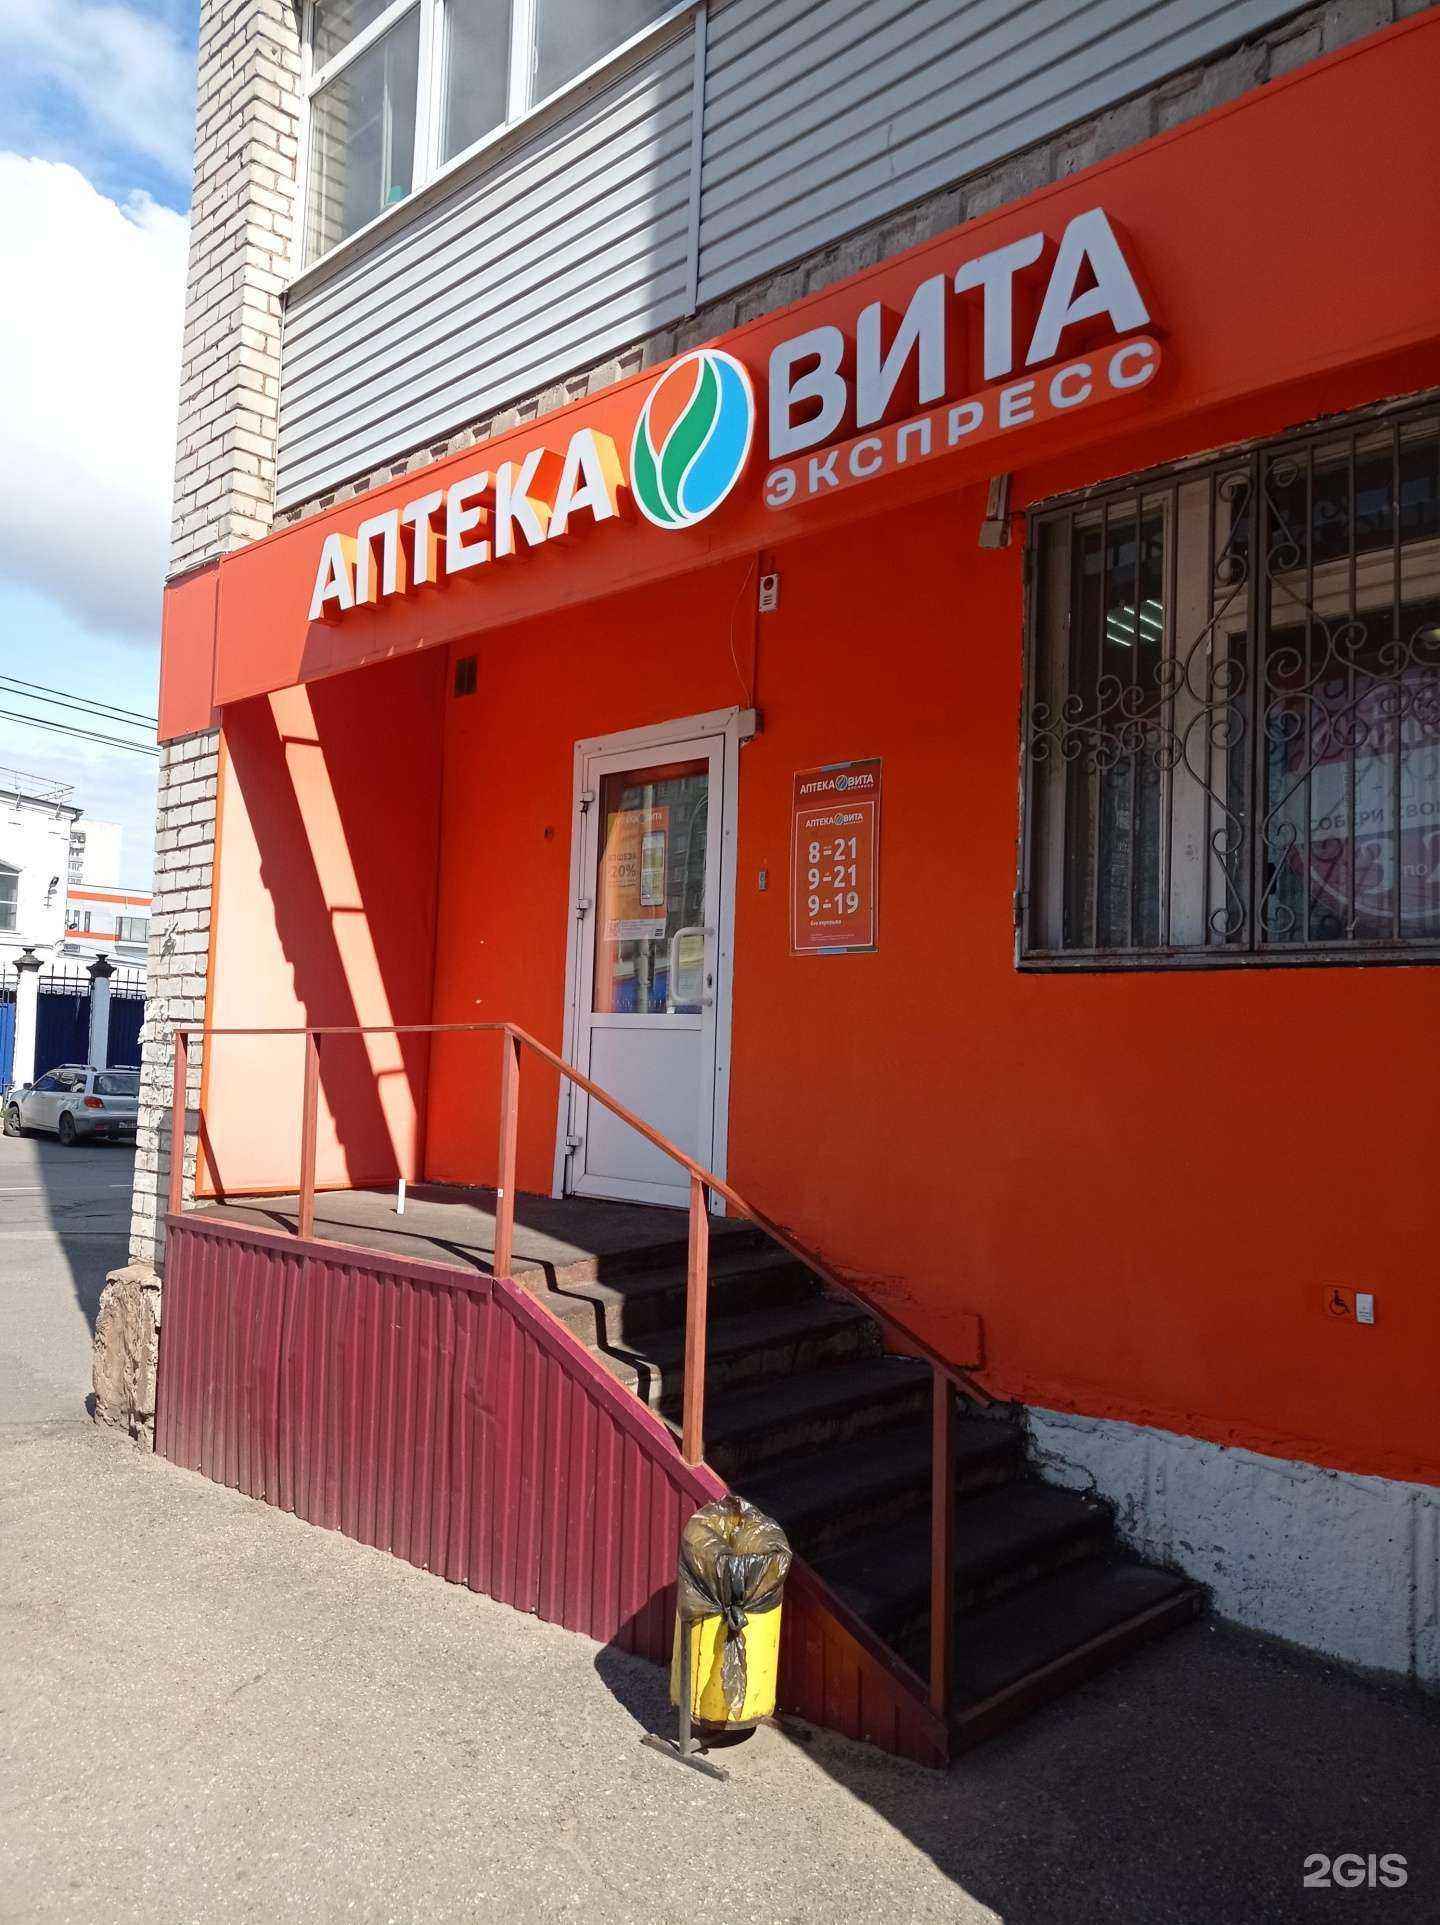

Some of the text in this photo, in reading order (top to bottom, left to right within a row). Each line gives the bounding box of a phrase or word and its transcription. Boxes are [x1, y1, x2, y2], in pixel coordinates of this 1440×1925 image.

[307, 208, 1151, 622] АПТЕКА ВИТА
[766, 341, 1156, 507] ЭКСПРЕСС
[799, 773, 875, 795] АПТЕКА ВИТА
[805, 816, 834, 828] АПТЕКА
[843, 812, 864, 823] ВИТА
